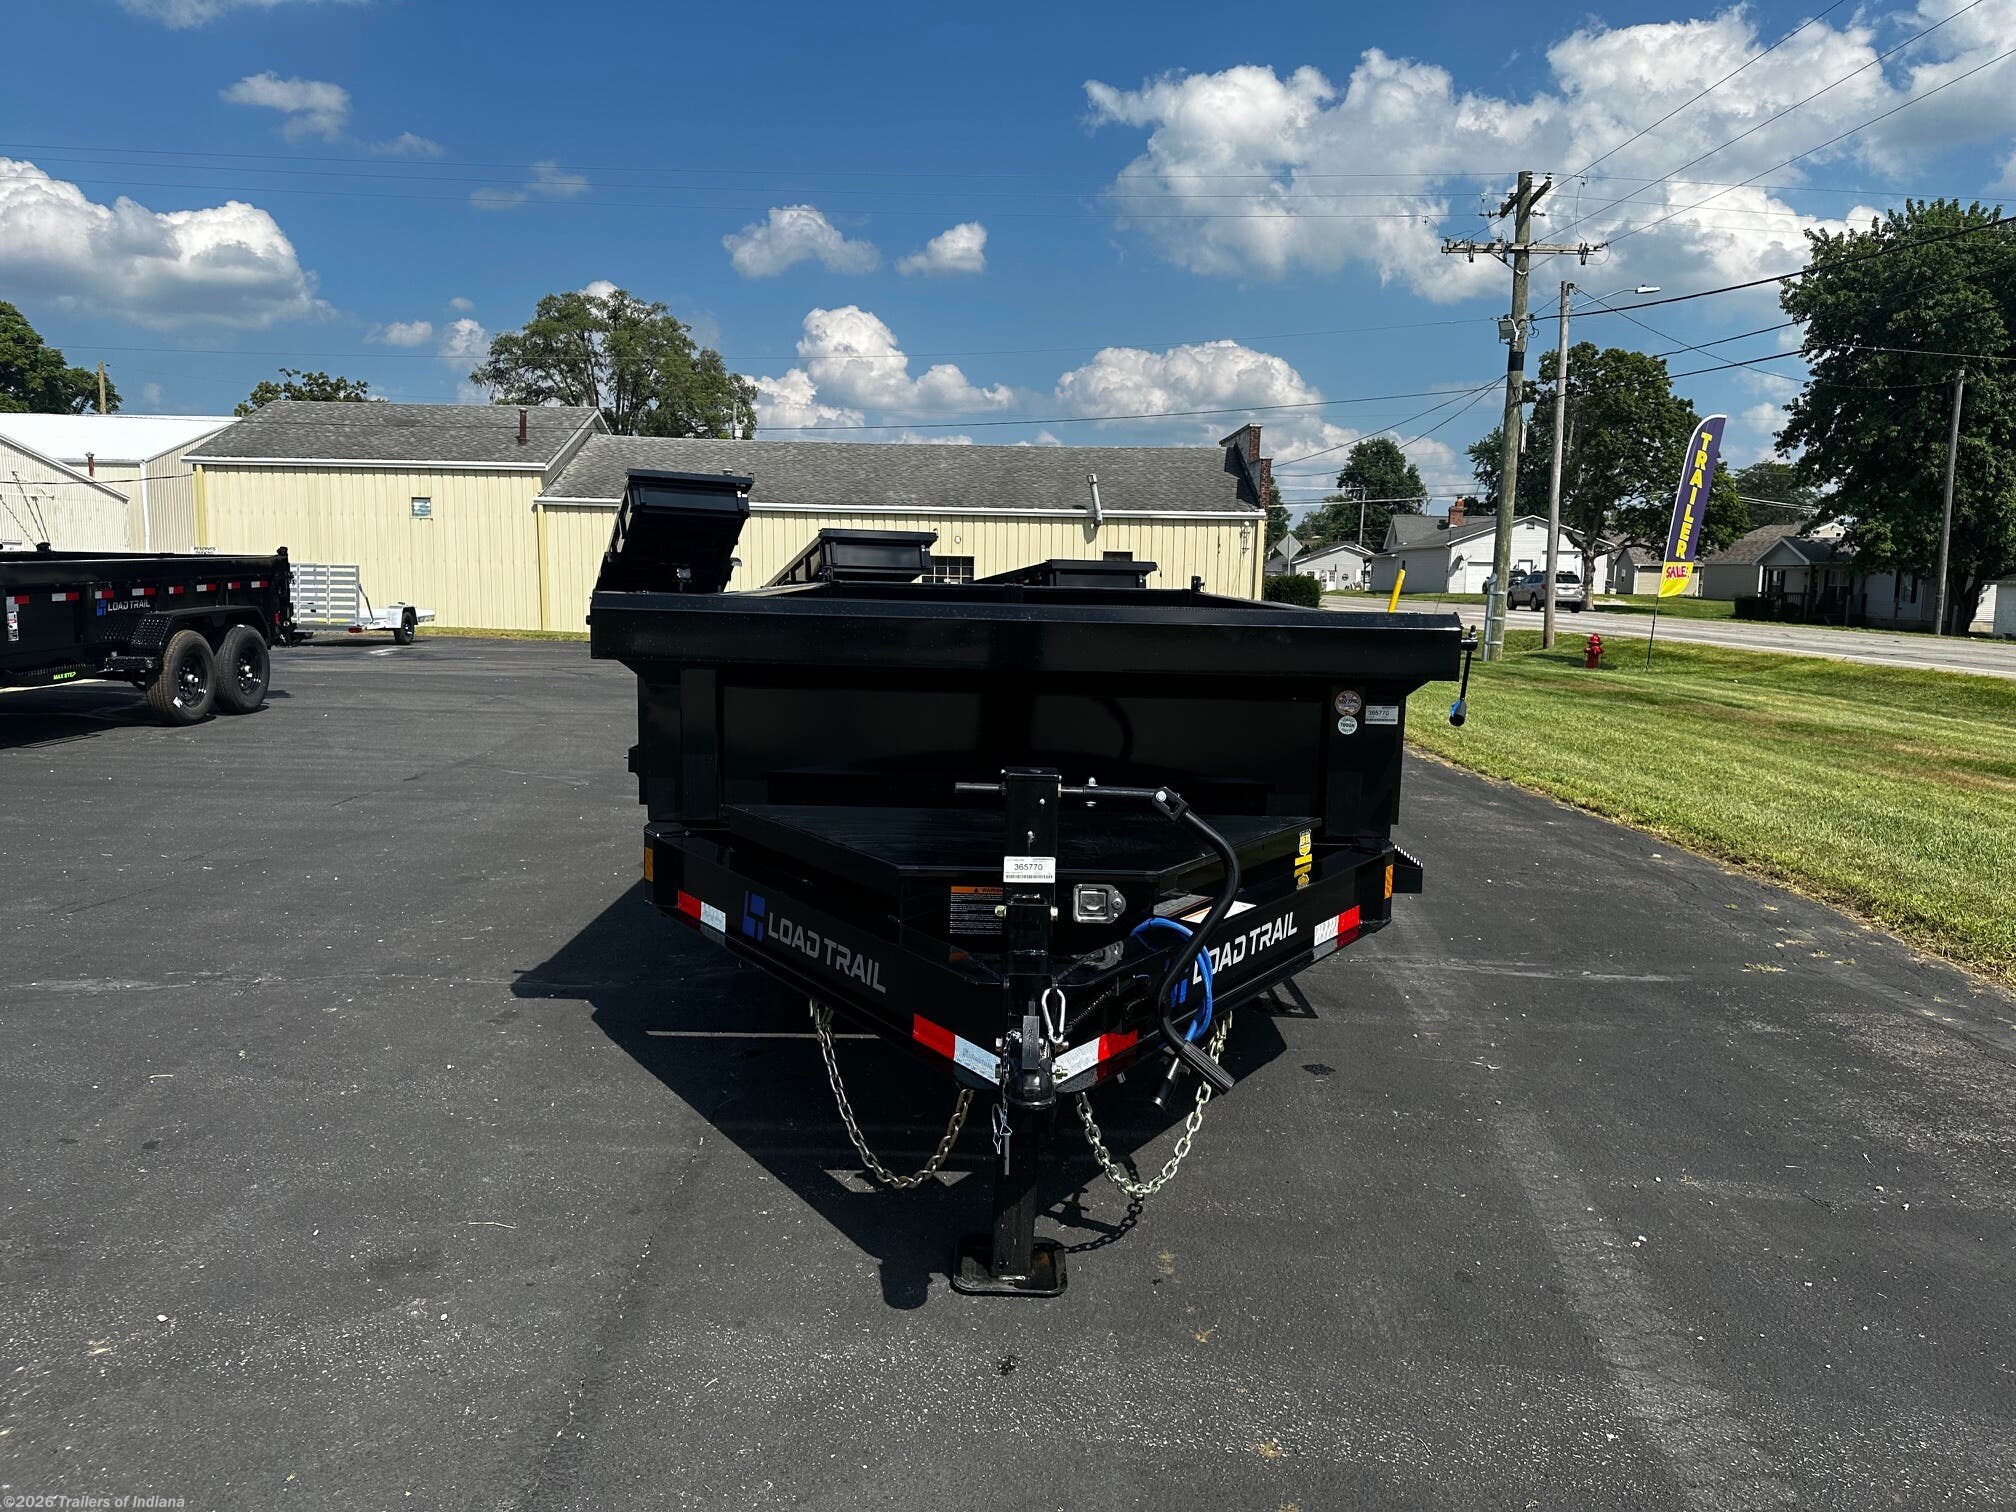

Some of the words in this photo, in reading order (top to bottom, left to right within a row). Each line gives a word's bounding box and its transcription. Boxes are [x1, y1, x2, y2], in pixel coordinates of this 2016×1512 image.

[1675, 432, 1713, 560] TRAILER
[108, 601, 128, 611] LOAD
[129, 600, 150, 609] TRAIL
[1014, 863, 1043, 871] 365770
[768, 912, 820, 959] LOAD
[823, 939, 886, 993] TRAIL
[1193, 935, 1247, 985] LOAD
[1250, 912, 1298, 955] TRAIL
